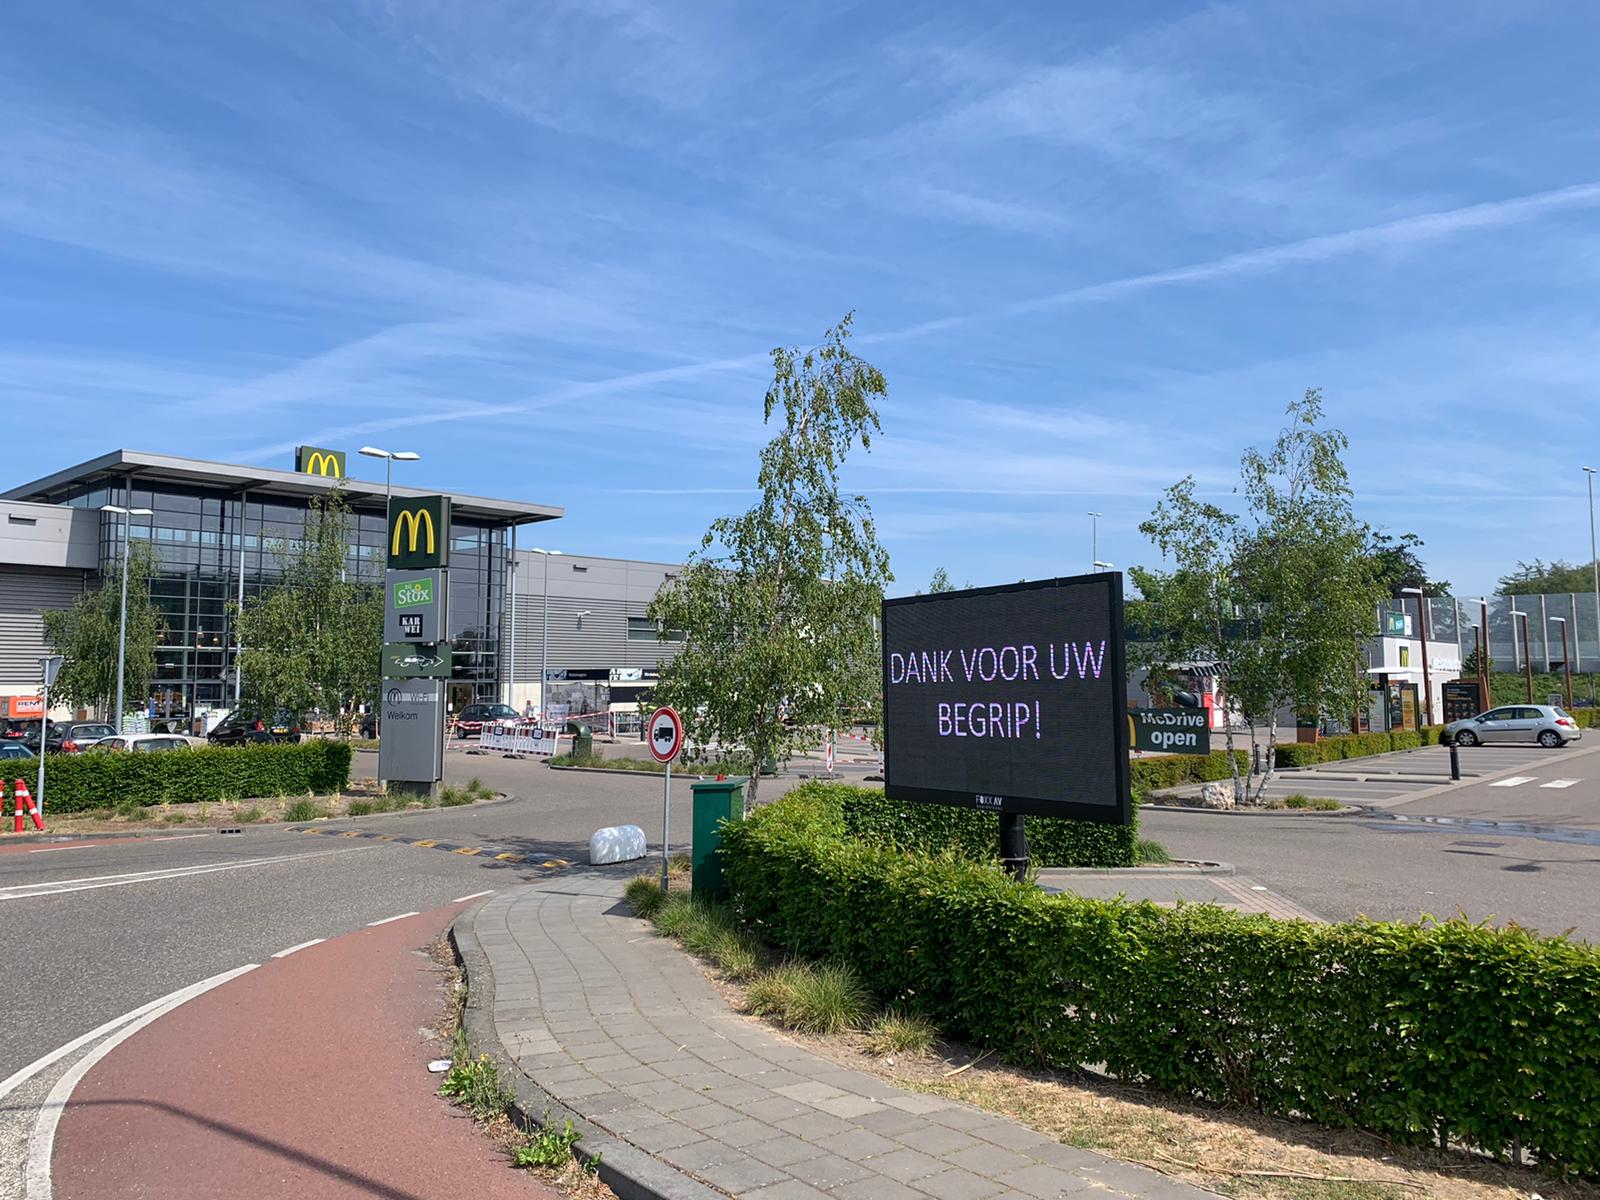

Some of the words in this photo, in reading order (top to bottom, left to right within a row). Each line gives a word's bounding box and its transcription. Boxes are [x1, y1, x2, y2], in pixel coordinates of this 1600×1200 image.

[402, 617, 421, 626] KAR
[404, 625, 420, 634] WEI
[890, 650, 955, 684] DANK
[960, 645, 1040, 682] VOOR
[1049, 640, 1106, 680] UW
[386, 710, 418, 721] Welkom
[938, 701, 1041, 740] BEGRIP!
[1140, 712, 1205, 727] McDrive
[1150, 731, 1197, 749] open
